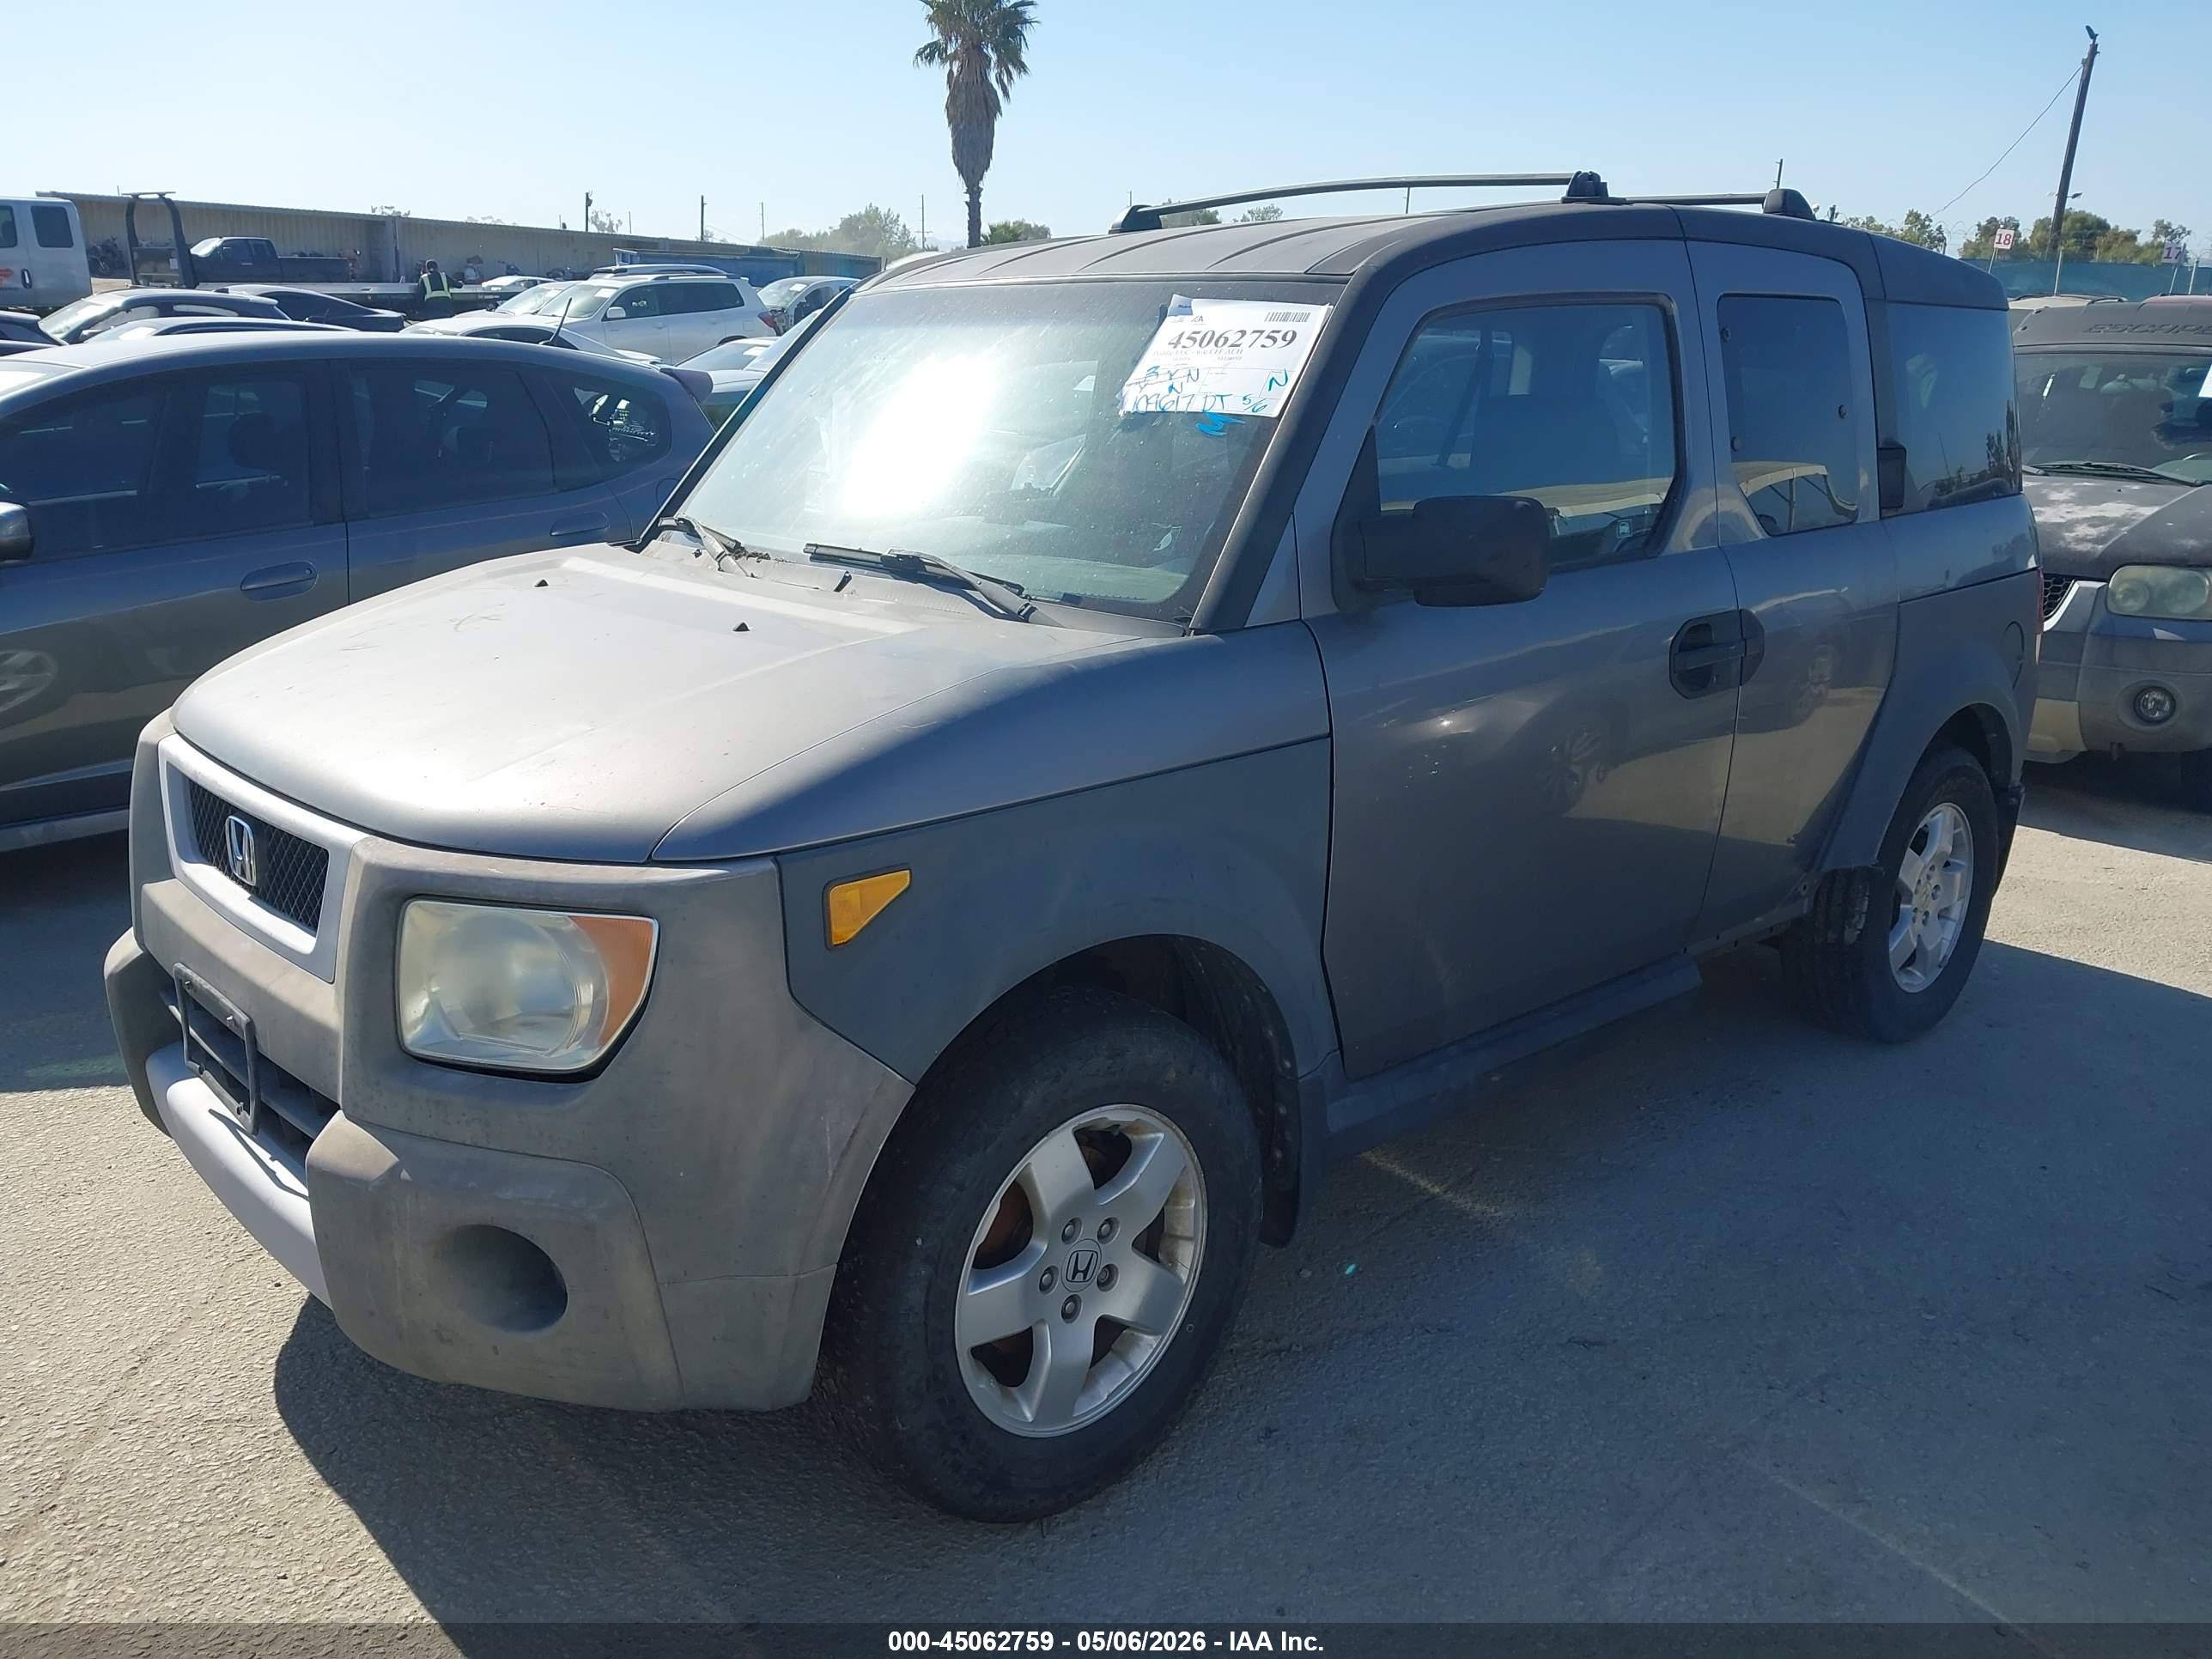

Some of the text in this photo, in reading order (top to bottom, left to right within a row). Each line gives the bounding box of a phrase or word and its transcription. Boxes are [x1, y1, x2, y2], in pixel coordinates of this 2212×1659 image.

[1995, 233, 2012, 246] 18
[2164, 246, 2182, 259] 17
[1167, 329, 1297, 349] 45062759
[1268, 368, 1288, 392] N
[1243, 393, 1268, 412] 5/6
